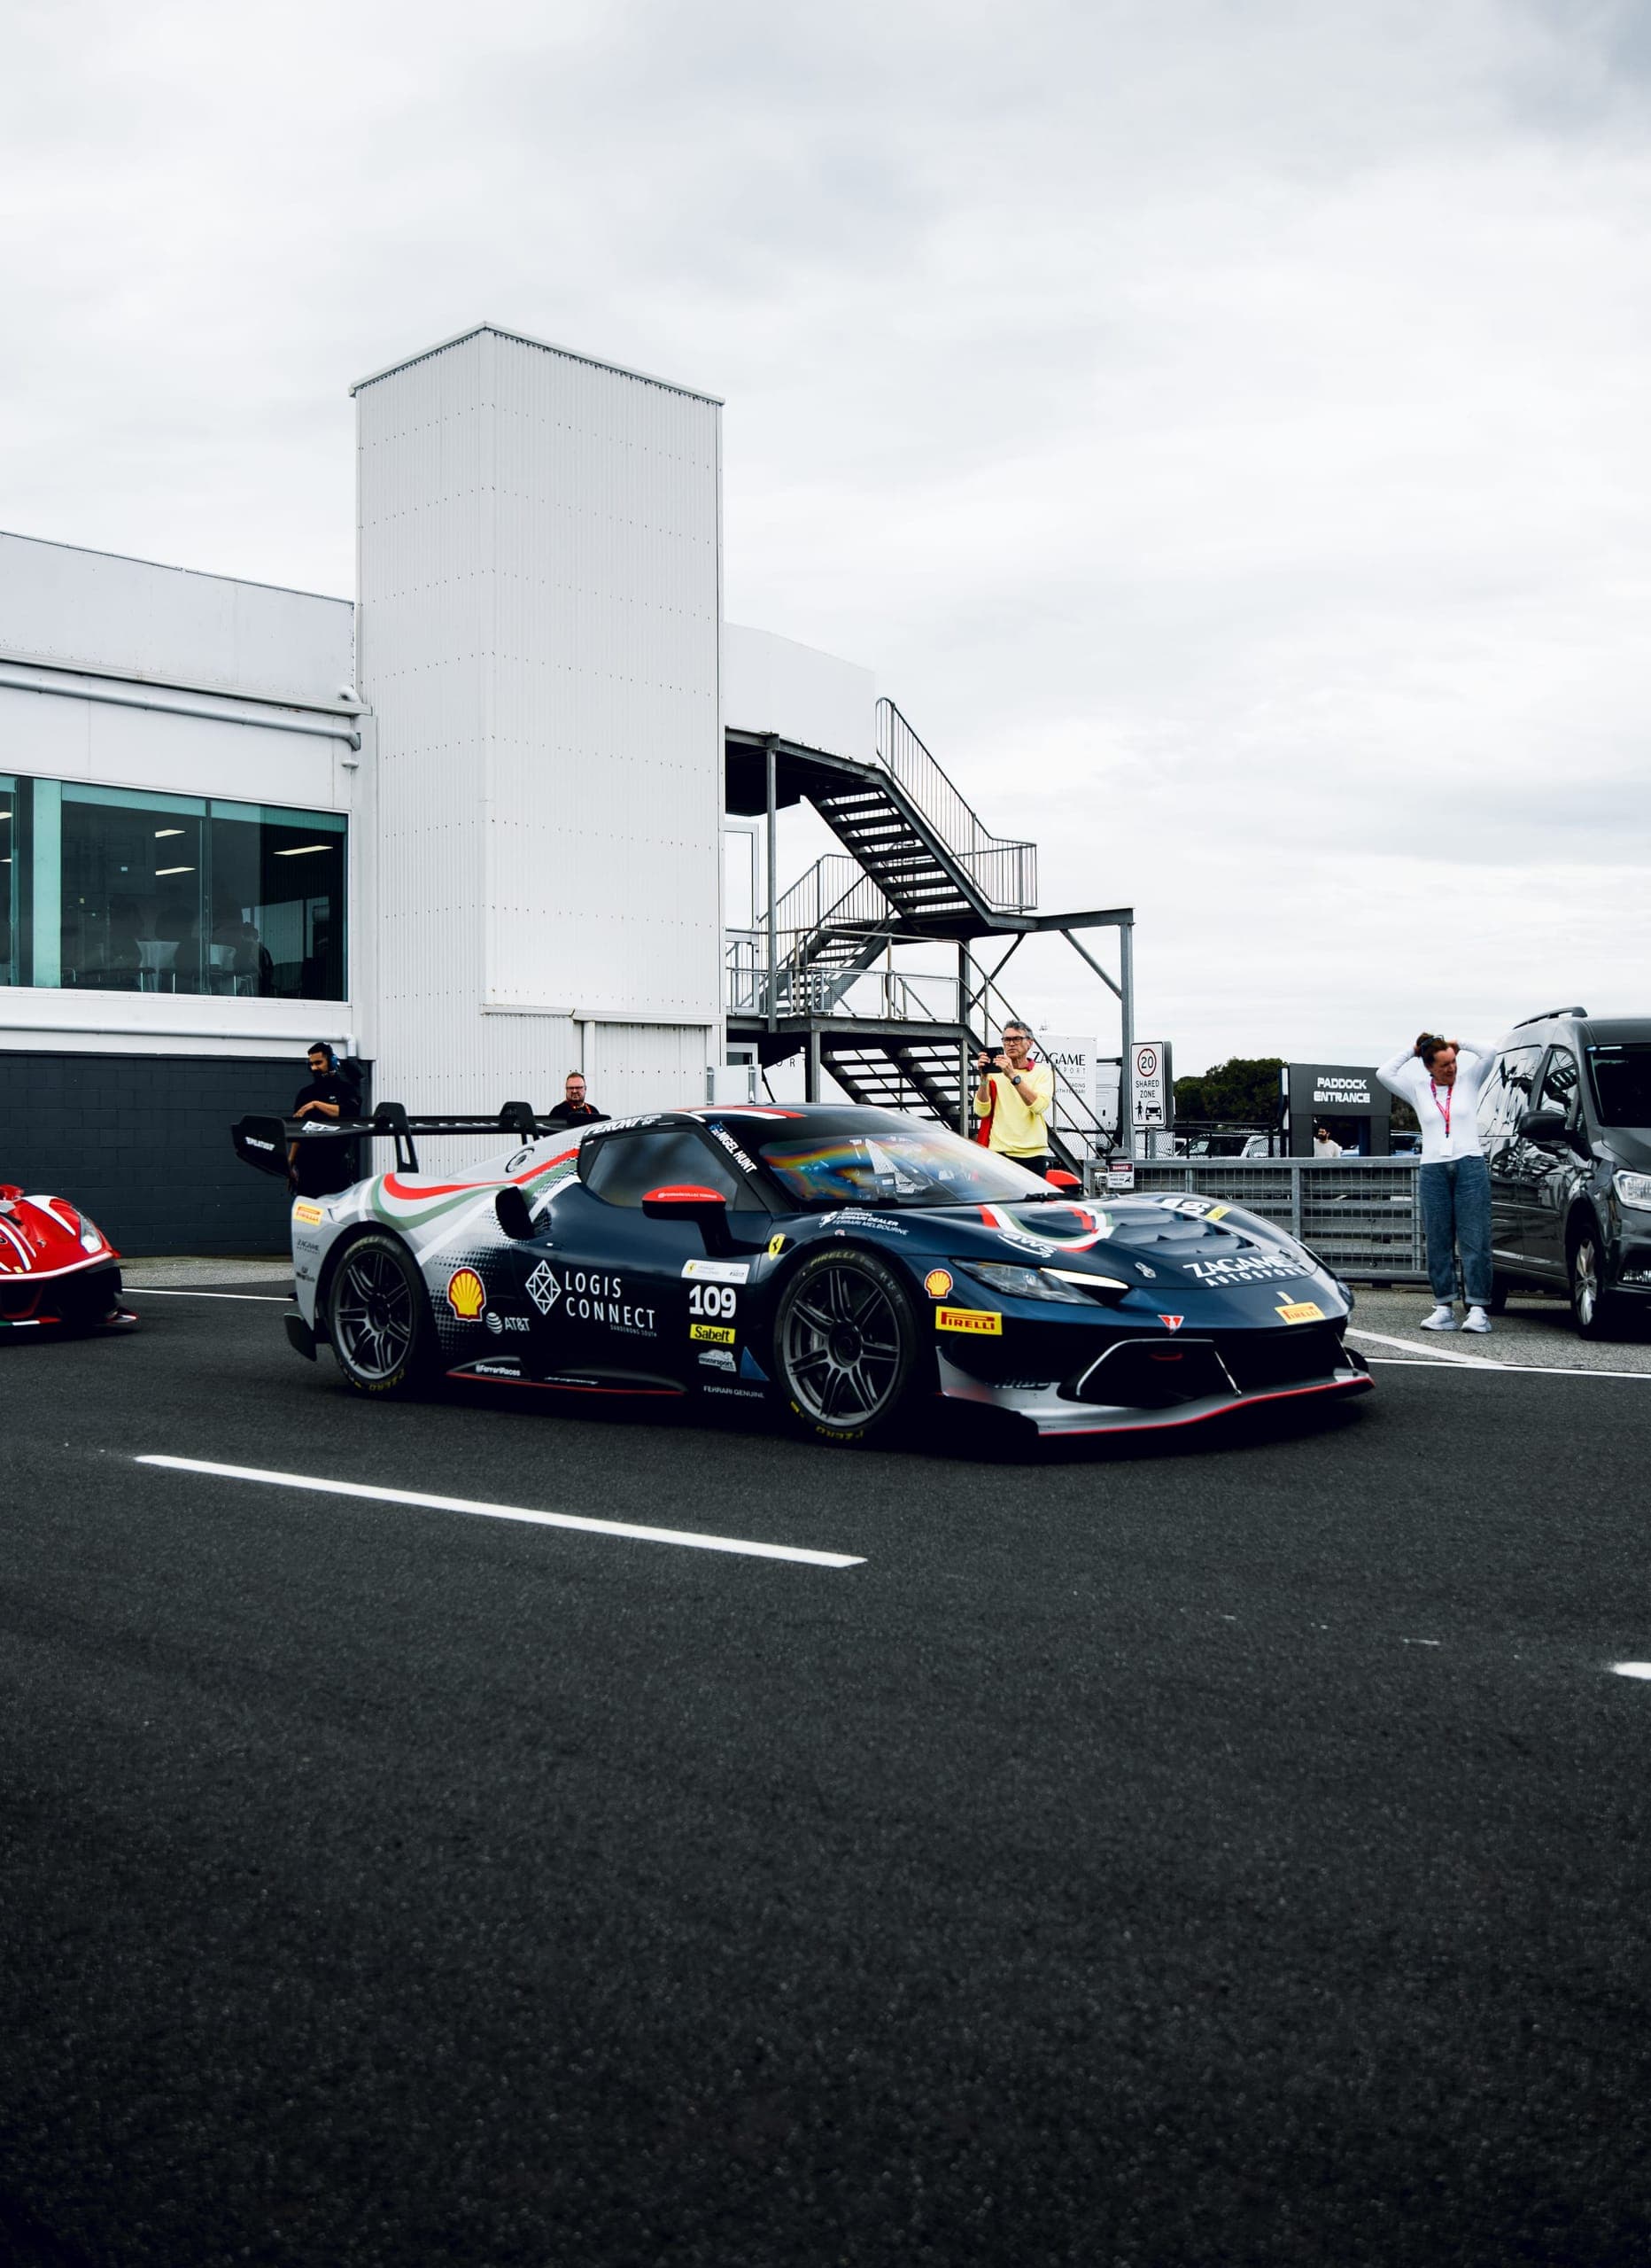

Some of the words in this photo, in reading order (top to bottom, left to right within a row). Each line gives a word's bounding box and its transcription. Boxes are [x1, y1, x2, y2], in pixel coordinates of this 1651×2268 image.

[1141, 1056, 1153, 1069] 20
[1136, 1079, 1159, 1088] SHARED
[1317, 1077, 1367, 1090] PADDOCK
[1140, 1090, 1156, 1099] ZONE
[1314, 1091, 1370, 1103] ENTRANCE
[717, 1131, 738, 1153] NIGEL
[733, 1150, 757, 1174] HUNT
[862, 1222, 909, 1235] MELBOURNE
[868, 1217, 899, 1226] DEALER
[1183, 1255, 1295, 1278] ZAGAME
[565, 1270, 622, 1298] LOGIS
[1205, 1267, 1310, 1286] AUTOSPORT
[689, 1285, 737, 1318] 109
[565, 1297, 655, 1329] CONNECT
[941, 1311, 995, 1330] PIRELLI
[504, 1317, 530, 1332] AT&T
[694, 1326, 730, 1342] Sabelt
[703, 1385, 732, 1395] FERRARI
